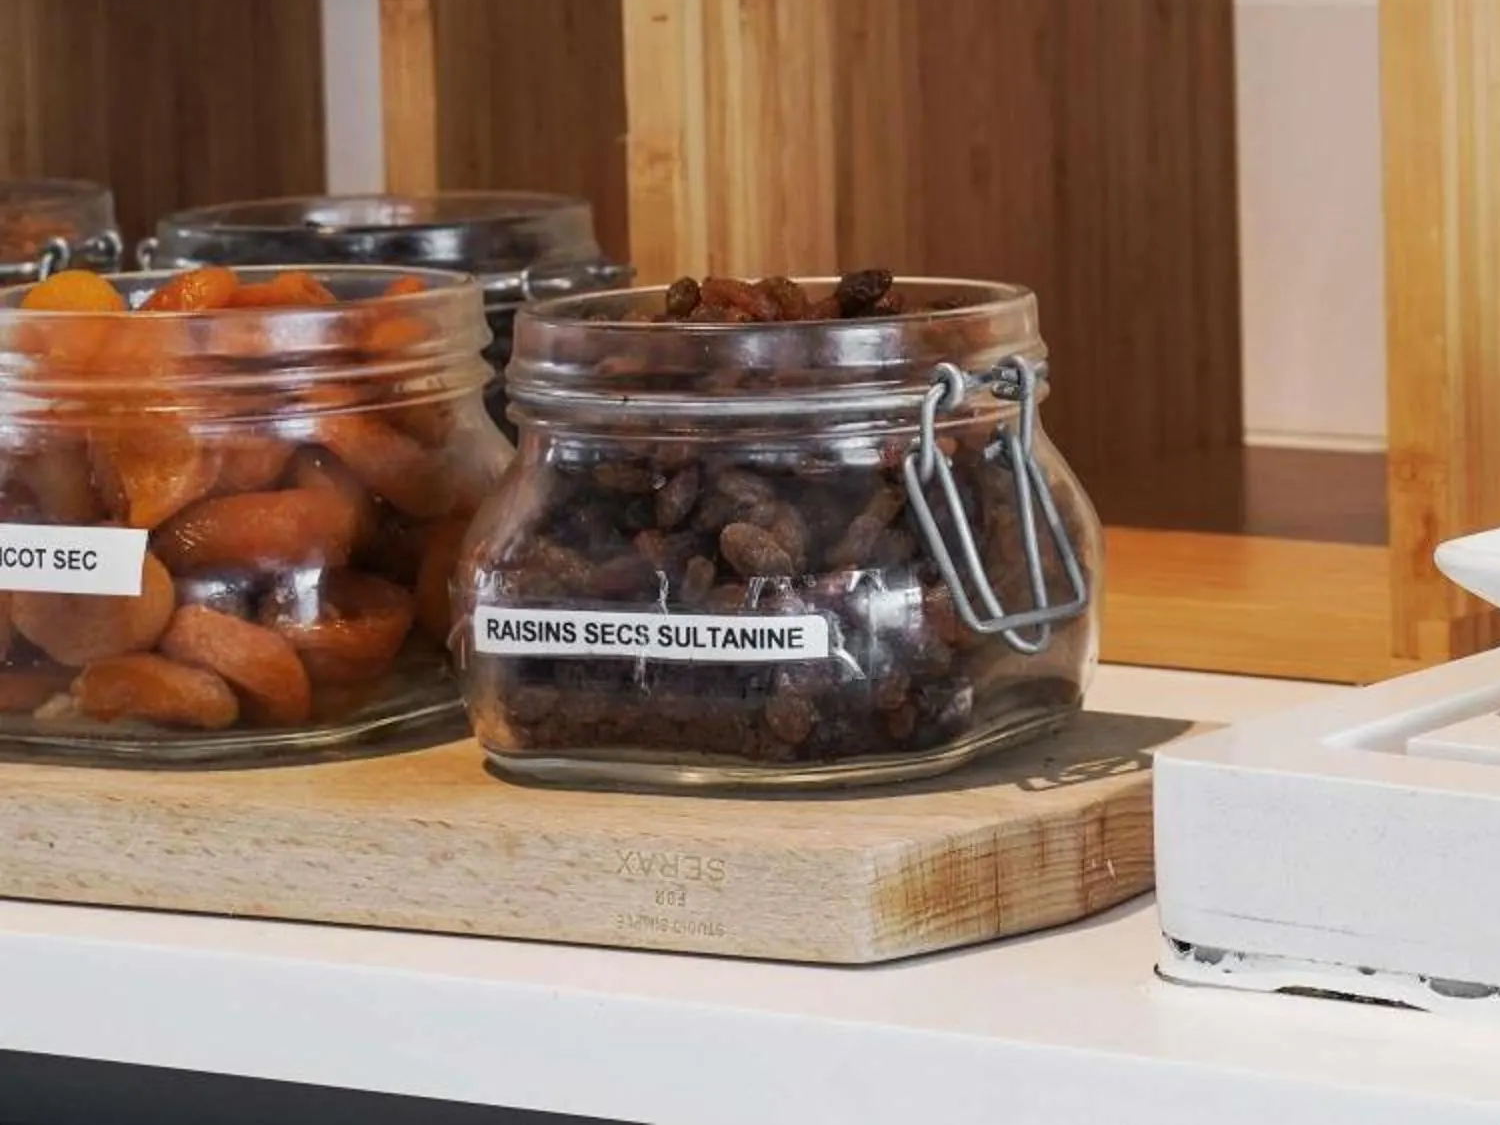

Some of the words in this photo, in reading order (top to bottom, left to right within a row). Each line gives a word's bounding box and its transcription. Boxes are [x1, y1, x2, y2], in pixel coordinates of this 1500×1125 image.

[52, 549, 98, 571] SEC
[486, 618, 577, 644] RAISINS
[584, 623, 649, 646] SECS
[657, 626, 805, 650] SULTANINE
[615, 849, 727, 883] SERAX
